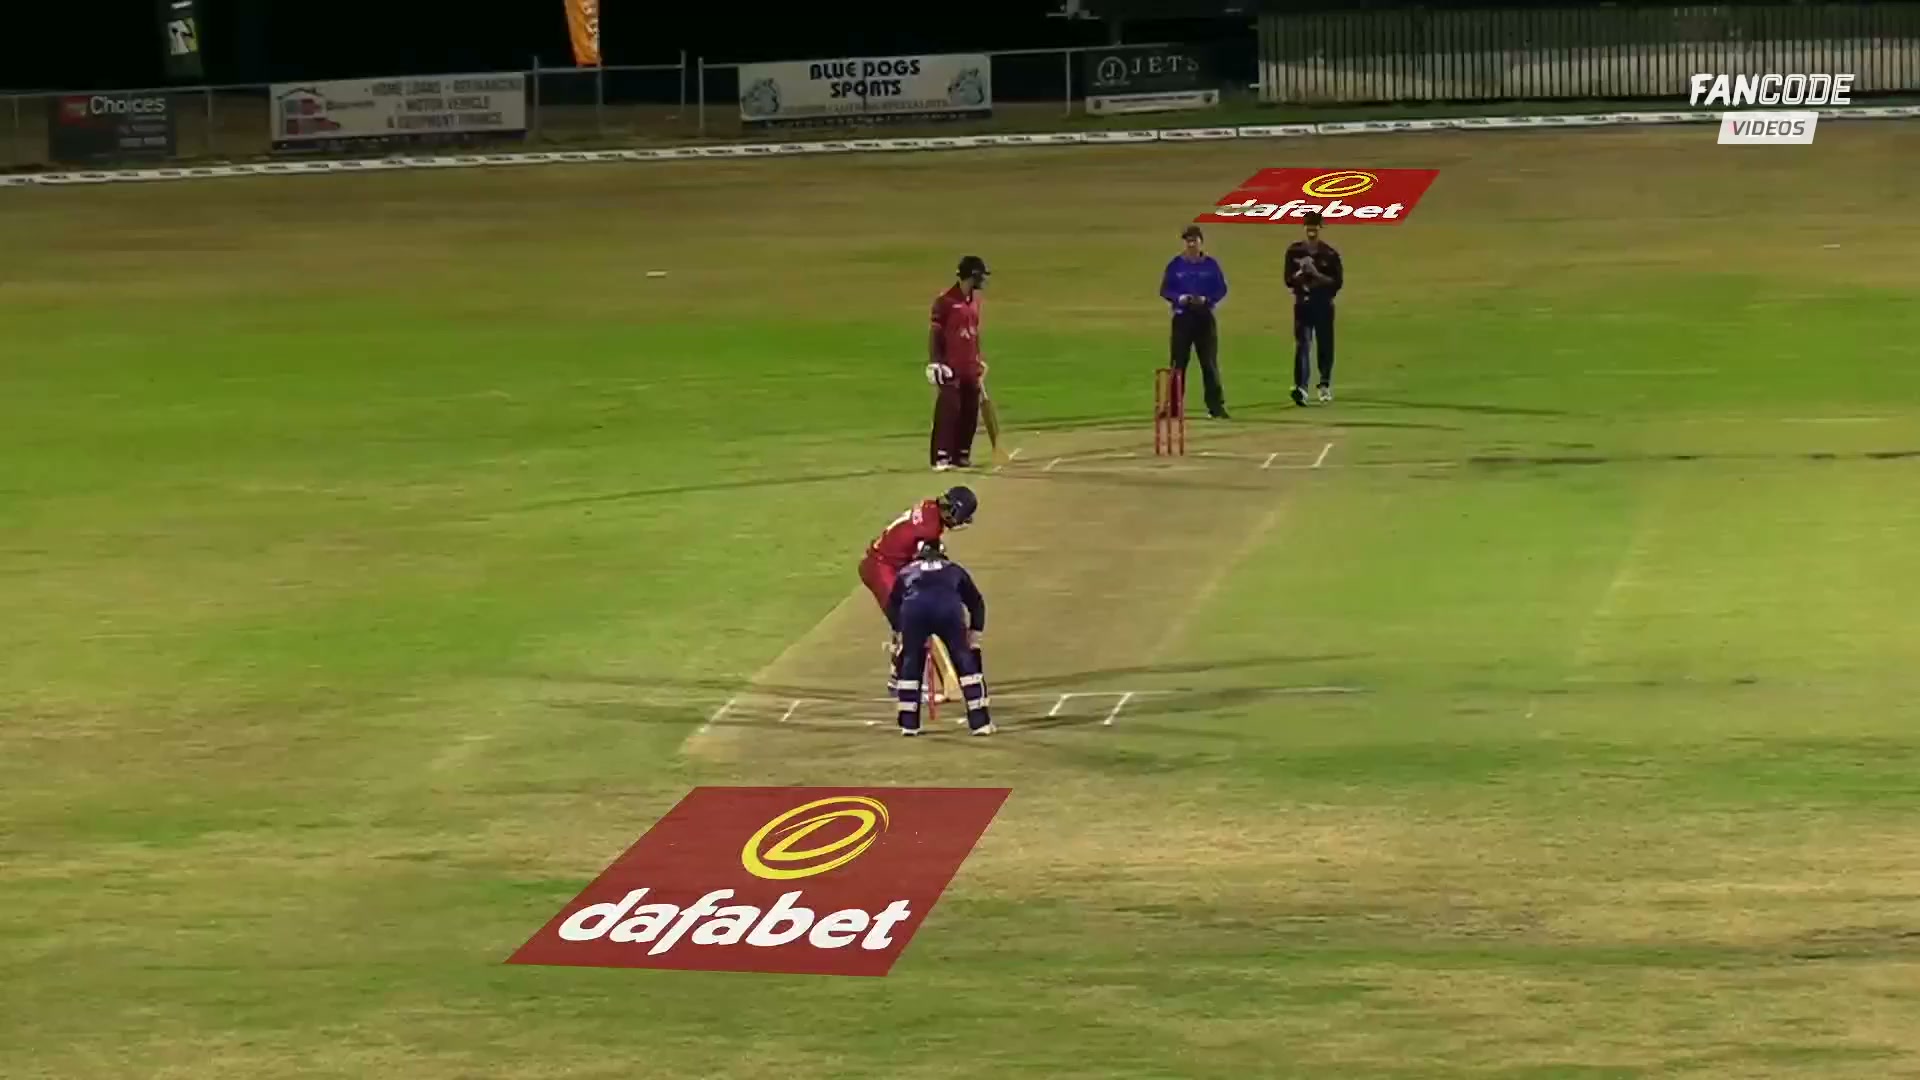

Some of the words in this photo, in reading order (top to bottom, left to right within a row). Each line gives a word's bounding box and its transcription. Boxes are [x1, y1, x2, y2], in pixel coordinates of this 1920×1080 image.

[810, 61, 857, 80] BLUE
[863, 59, 921, 77] DOGS
[1130, 55, 1200, 75] JETS
[830, 80, 902, 98] SPORTS
[90, 96, 166, 115] Choices
[1214, 199, 1405, 221] dafabet
[558, 887, 912, 956] dafabet
